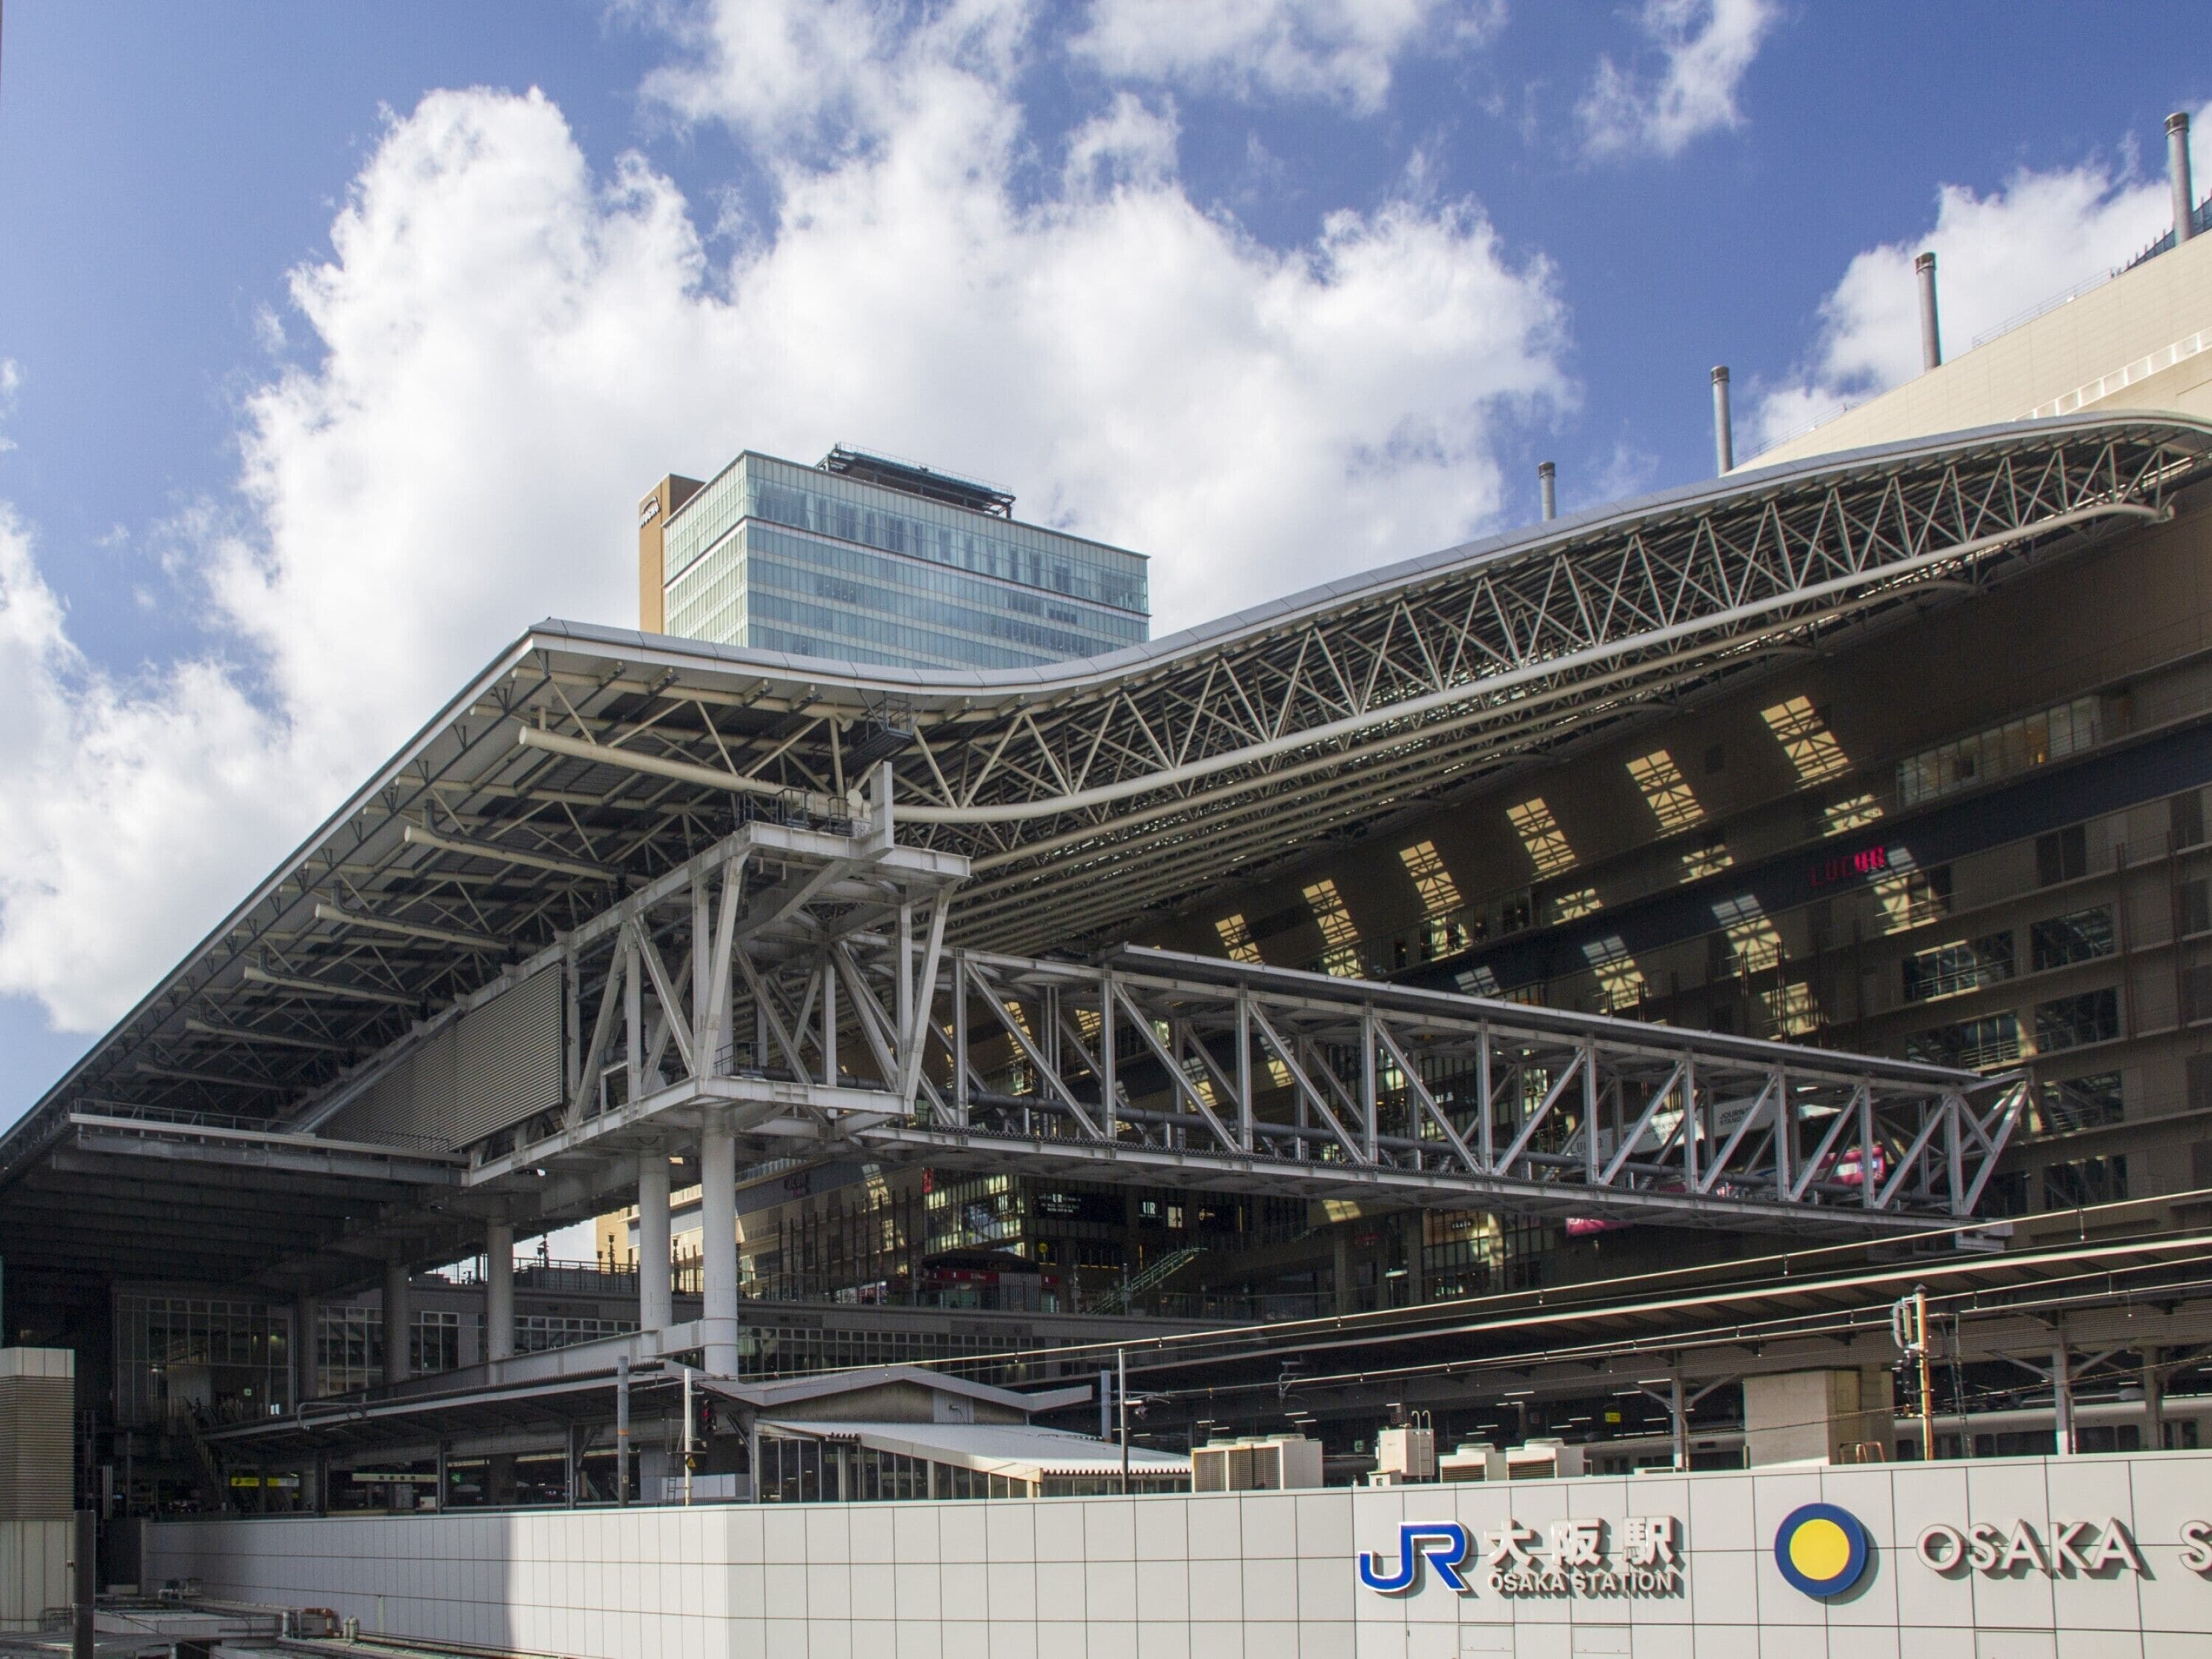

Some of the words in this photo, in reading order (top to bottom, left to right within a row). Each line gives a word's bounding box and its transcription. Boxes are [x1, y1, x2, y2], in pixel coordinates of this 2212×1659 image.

[1359, 1521, 1469, 1593] JR
[1484, 1516, 1674, 1566] 大阪駅
[1916, 1517, 2141, 1571] OSAKA
[1572, 1571, 1673, 1592] STATION
